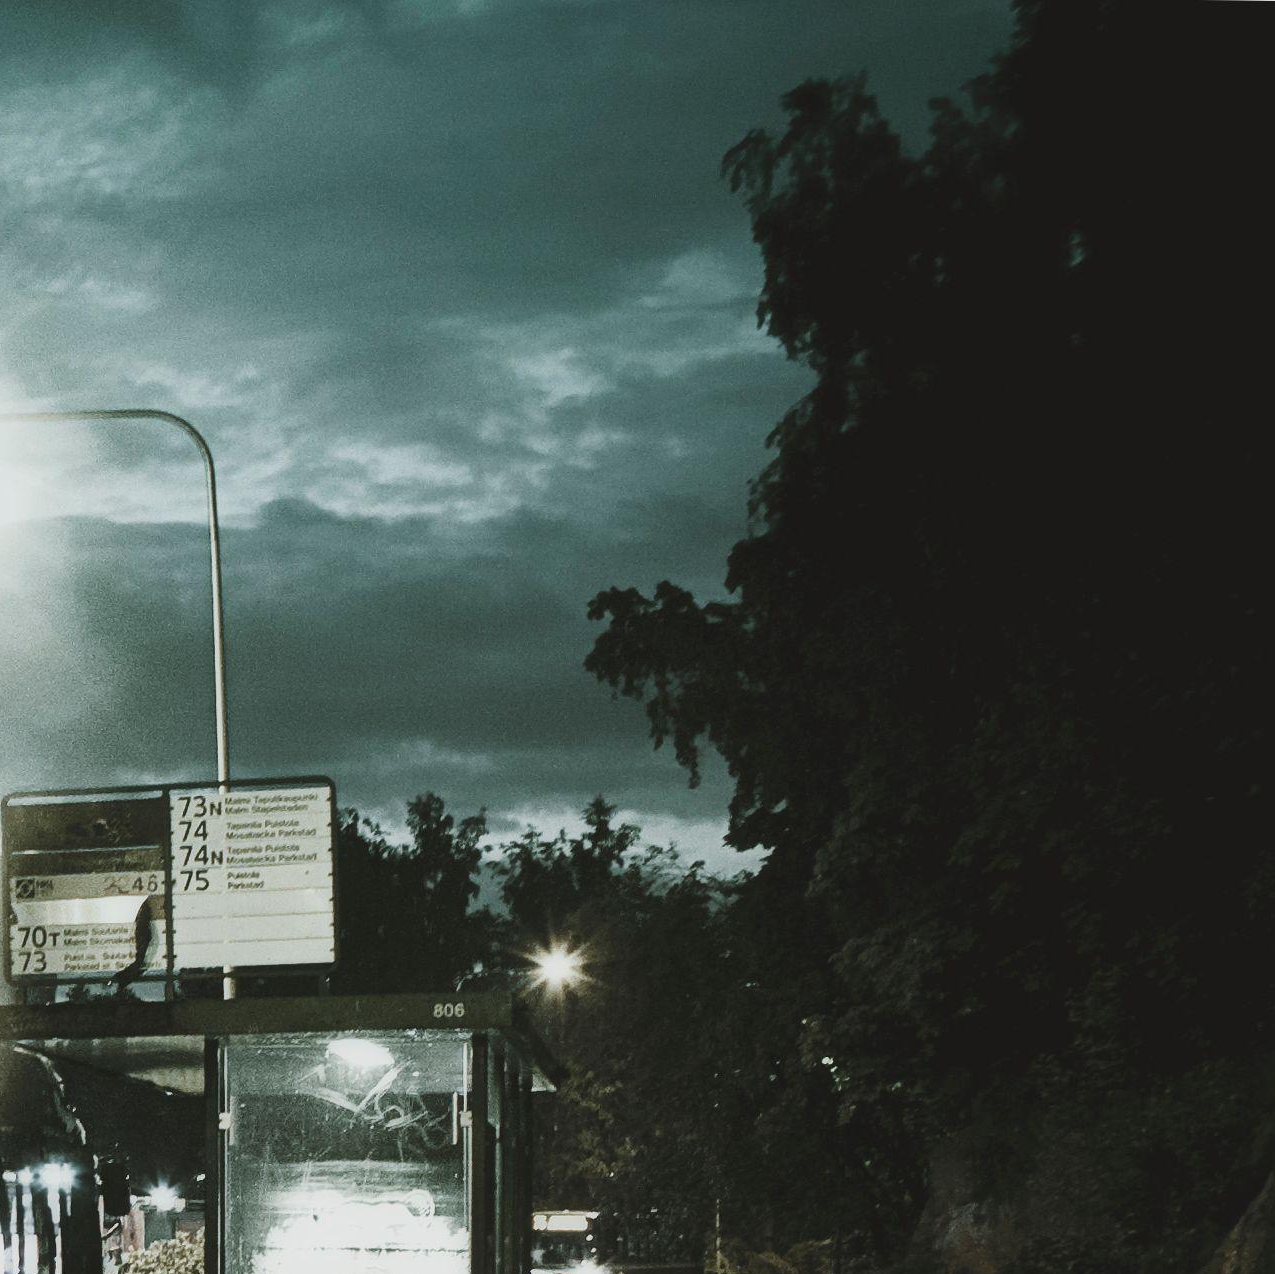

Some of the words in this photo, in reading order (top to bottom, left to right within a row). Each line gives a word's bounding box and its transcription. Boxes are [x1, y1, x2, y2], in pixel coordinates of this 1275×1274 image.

[178, 795, 222, 818] 73N
[179, 820, 209, 842] 74
[180, 844, 224, 867] 74N
[180, 869, 210, 892] 75
[17, 925, 61, 949] 70T
[18, 950, 47, 973] 73
[433, 1002, 465, 1018] 806
